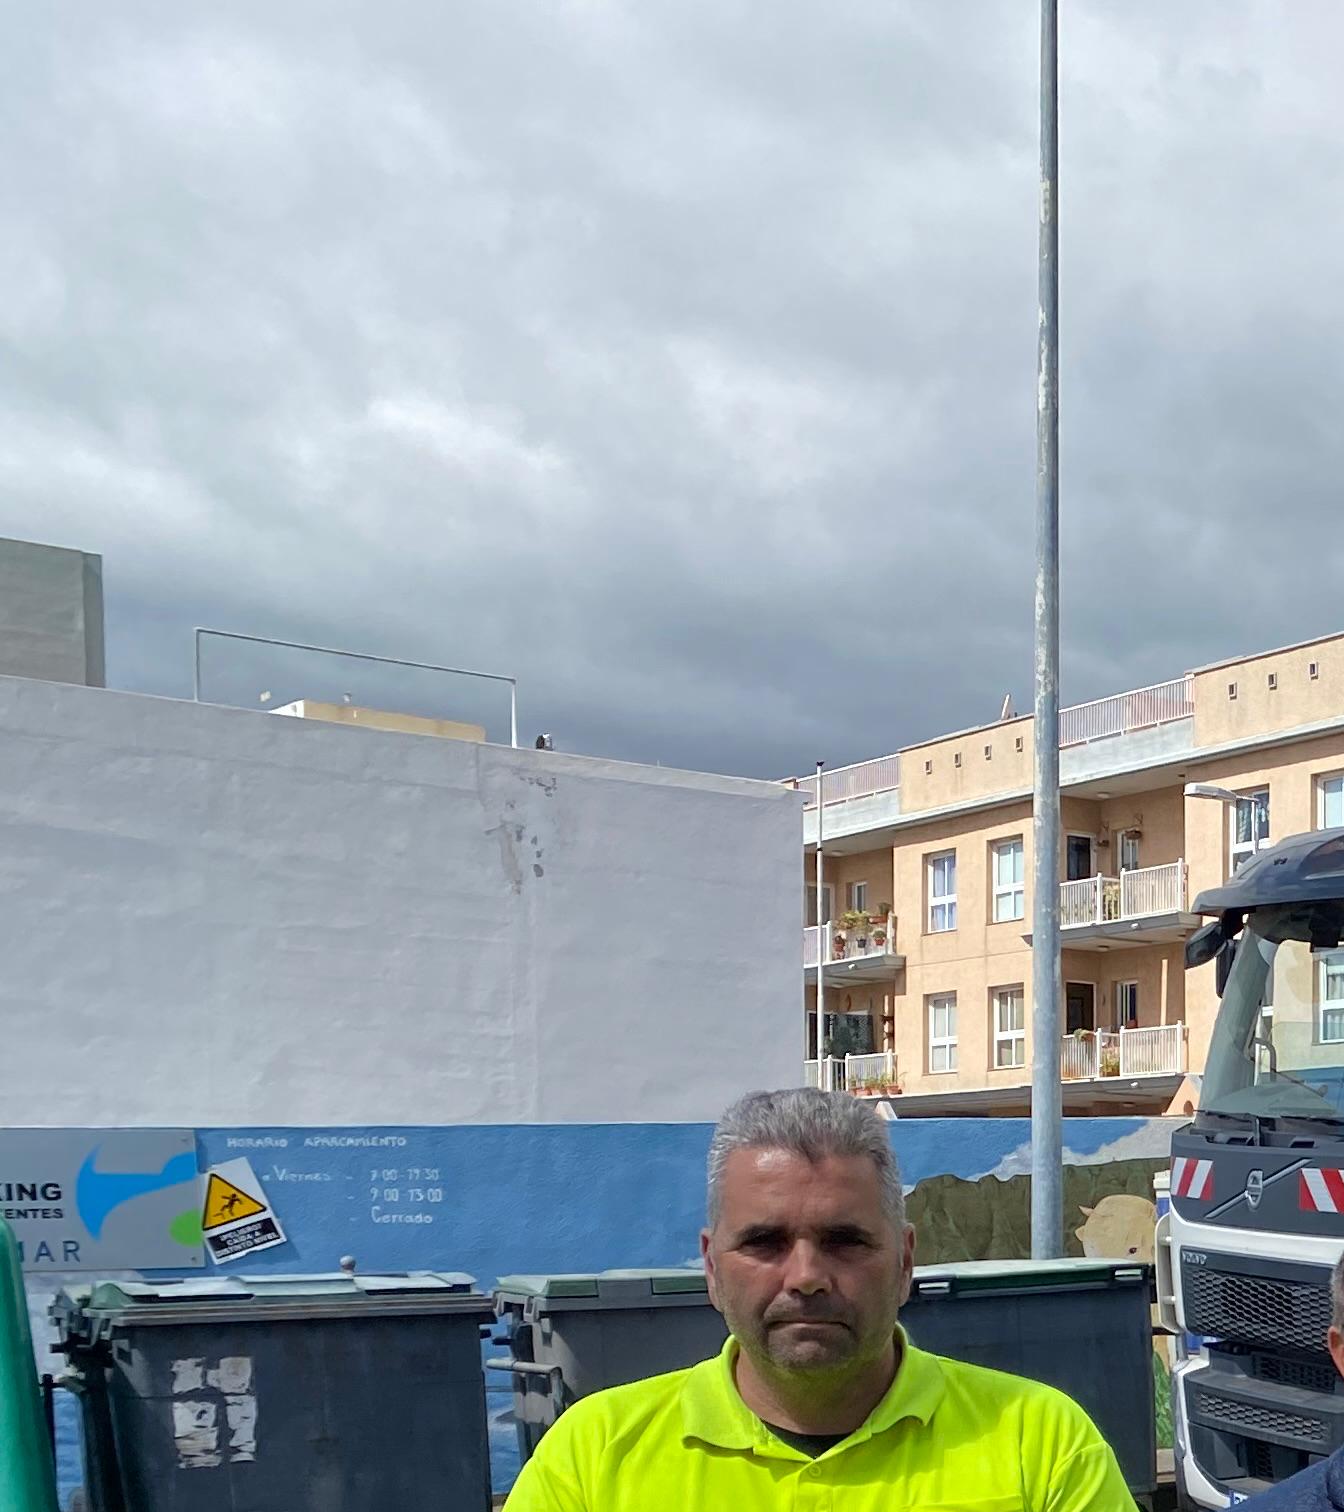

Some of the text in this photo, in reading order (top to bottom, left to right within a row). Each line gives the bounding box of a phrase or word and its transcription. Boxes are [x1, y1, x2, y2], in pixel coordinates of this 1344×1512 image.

[226, 1135, 407, 1148] HORARIO APARCAMIENTO
[0, 1183, 62, 1201] ING
[0, 1208, 63, 1219] ENTES
[370, 1205, 433, 1224] Cerrado
